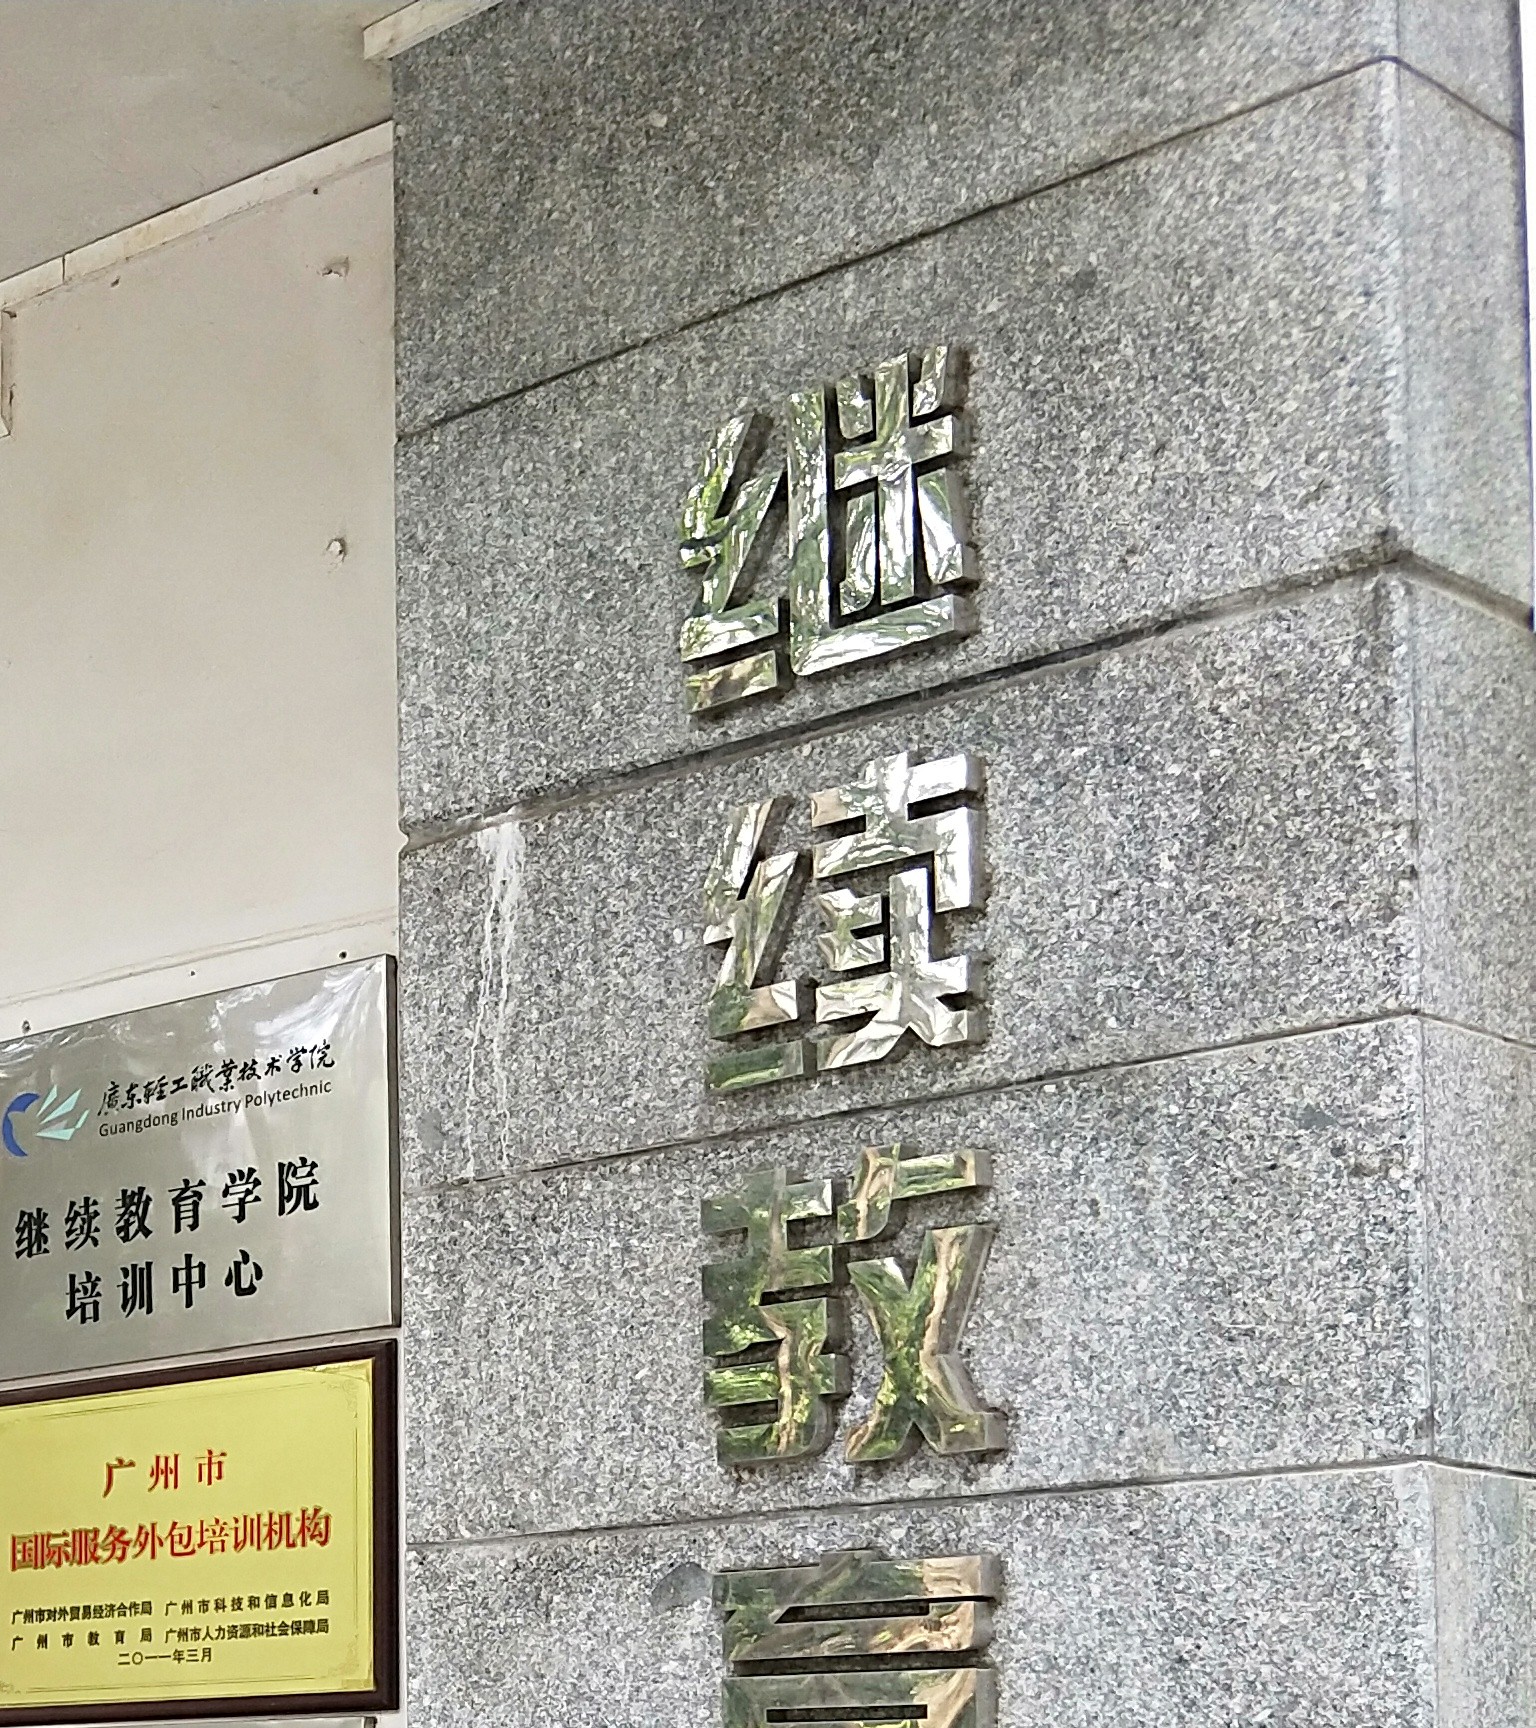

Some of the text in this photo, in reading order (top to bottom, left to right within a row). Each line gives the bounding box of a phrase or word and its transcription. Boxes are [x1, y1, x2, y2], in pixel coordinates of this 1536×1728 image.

[99, 1079, 332, 1137] Guangdong Industry Polytechnic
[14, 1156, 320, 1259] 继续教育学院
[65, 1249, 264, 1325] 培训中心
[101, 1448, 228, 1499] 广州市
[10, 1504, 332, 1572] 国际服务外包培训机构
[11, 1589, 330, 1625] 广州市对外贸易经济合作局 广州市科技和信息化局
[11, 1618, 330, 1651] 广州市教育局 广州市人力资源和社会保障局
